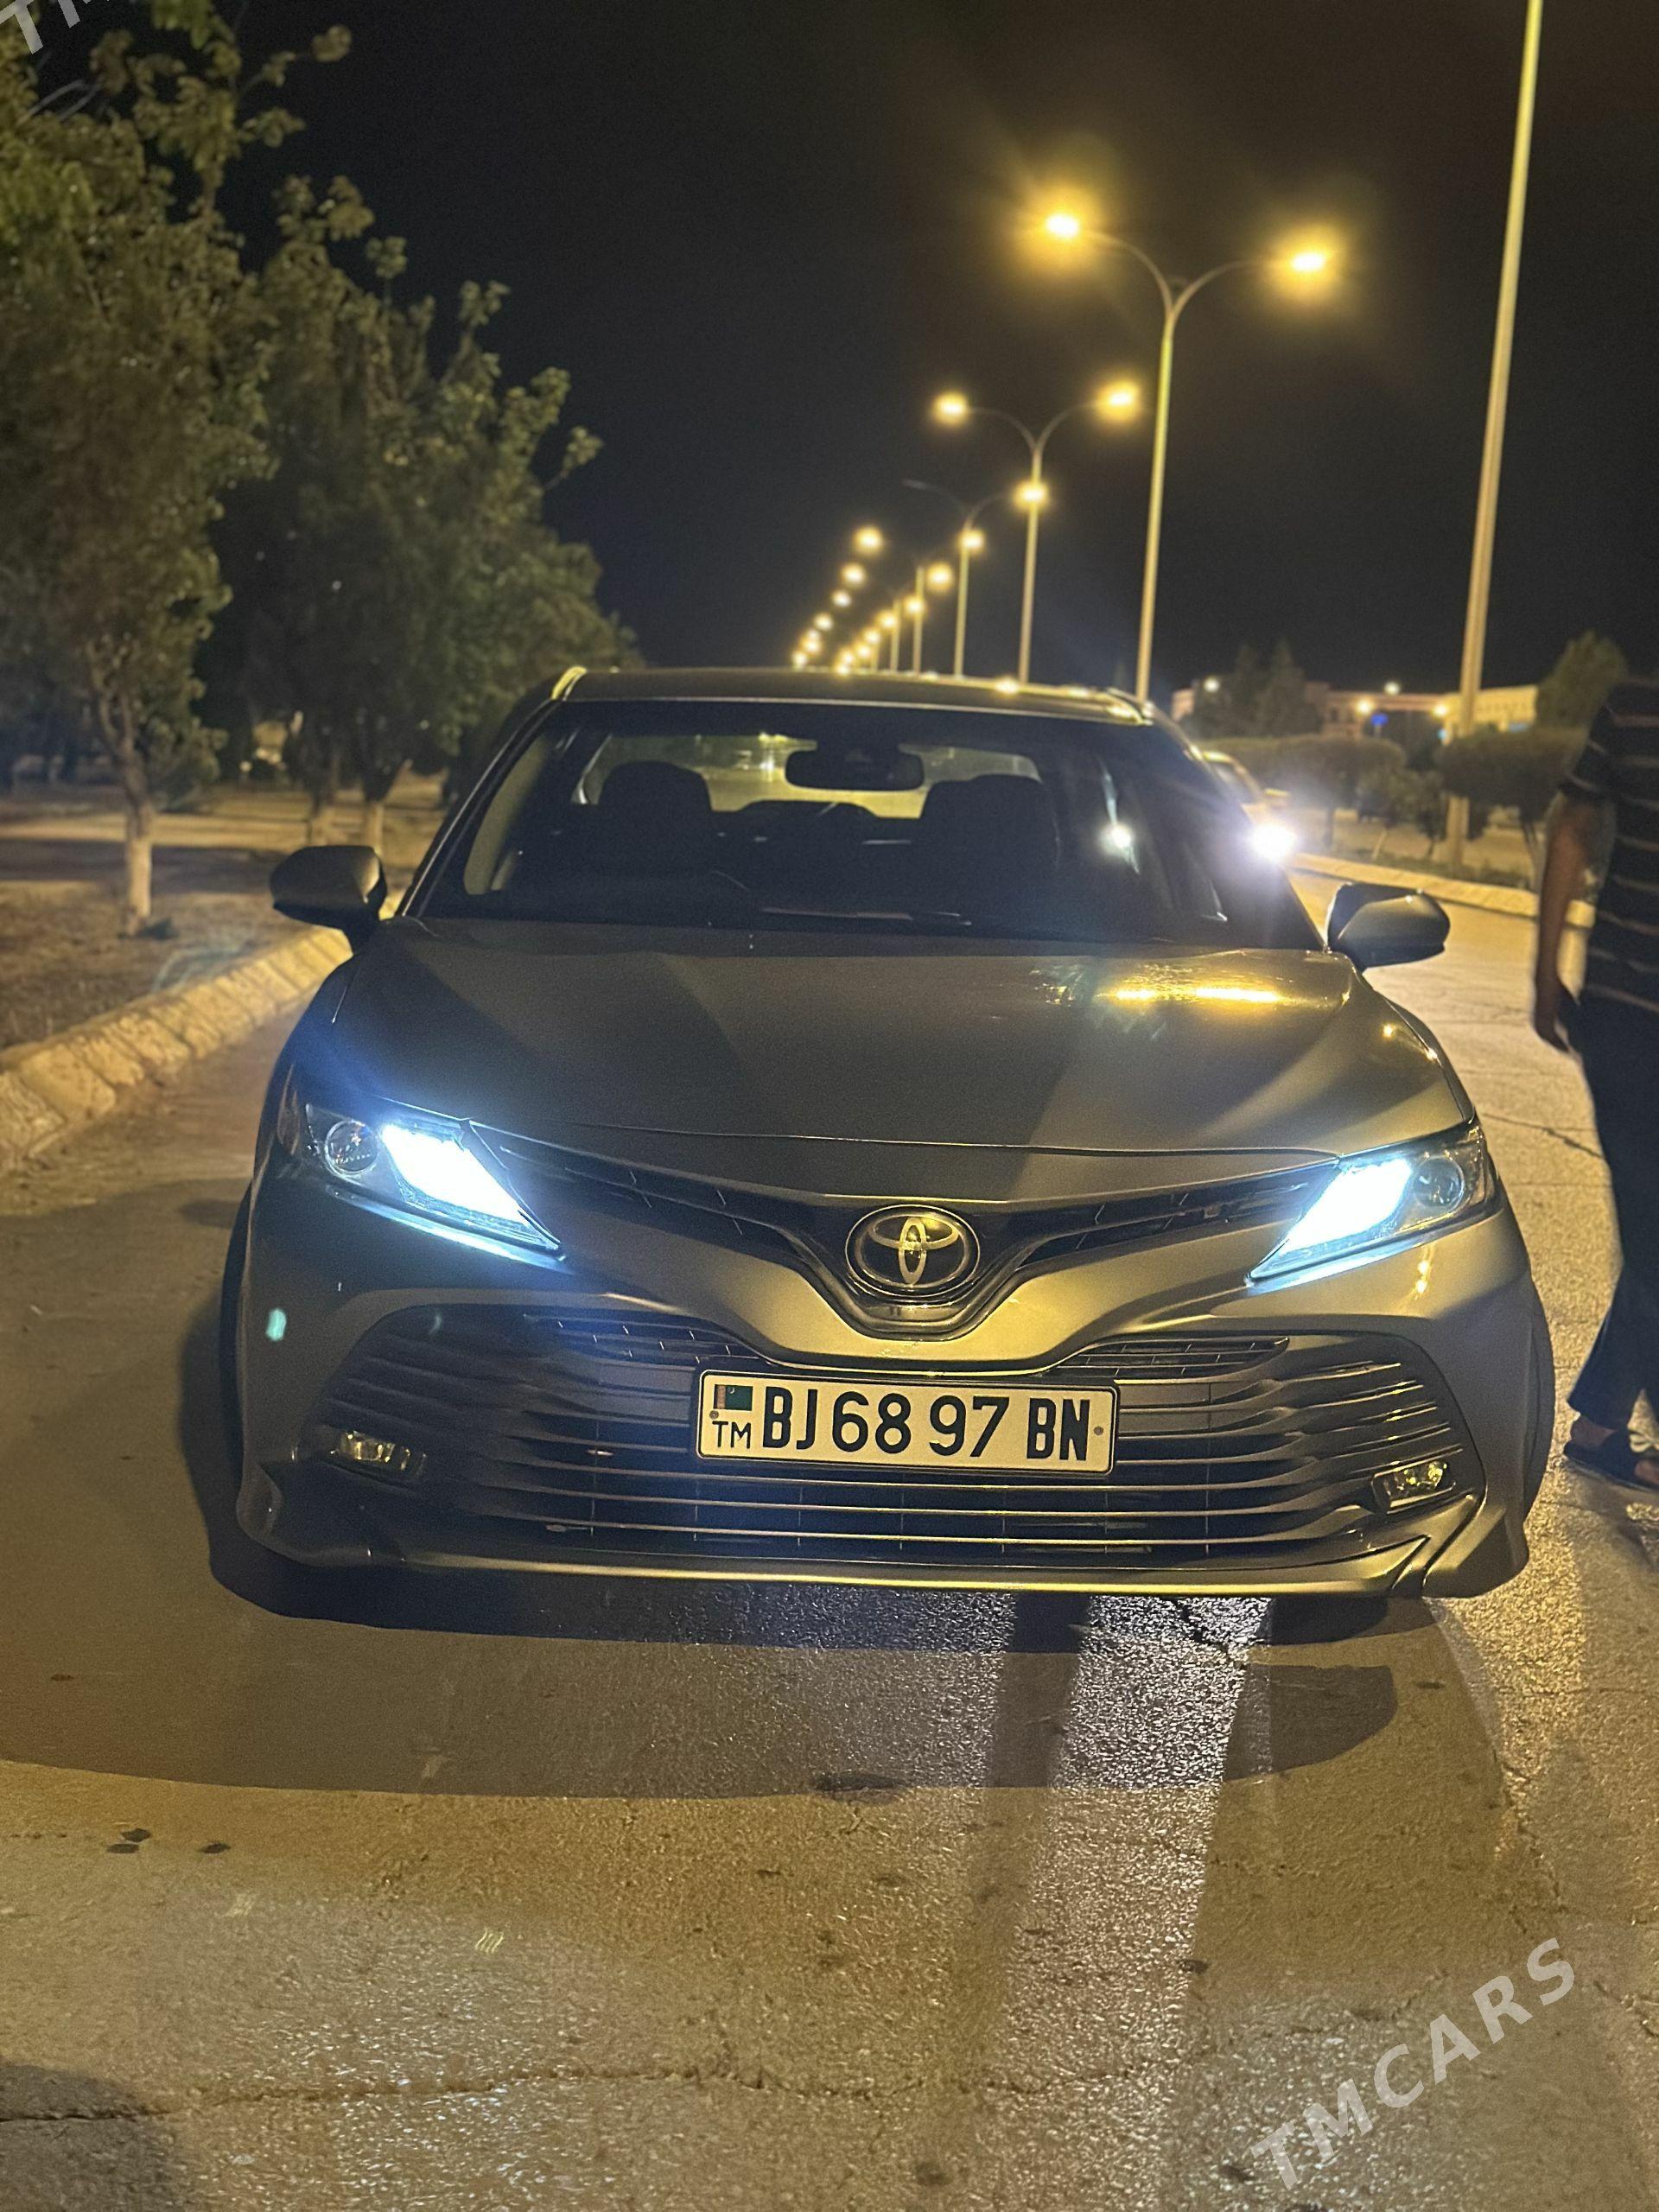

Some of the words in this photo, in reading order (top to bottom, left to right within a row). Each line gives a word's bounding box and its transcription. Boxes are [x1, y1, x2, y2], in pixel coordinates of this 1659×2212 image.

[712, 1421, 752, 1449] TM
[762, 1386, 818, 1450] BJ
[832, 1391, 912, 1454] 68
[930, 1395, 1009, 1457] 97
[1027, 1397, 1090, 1461] BN
